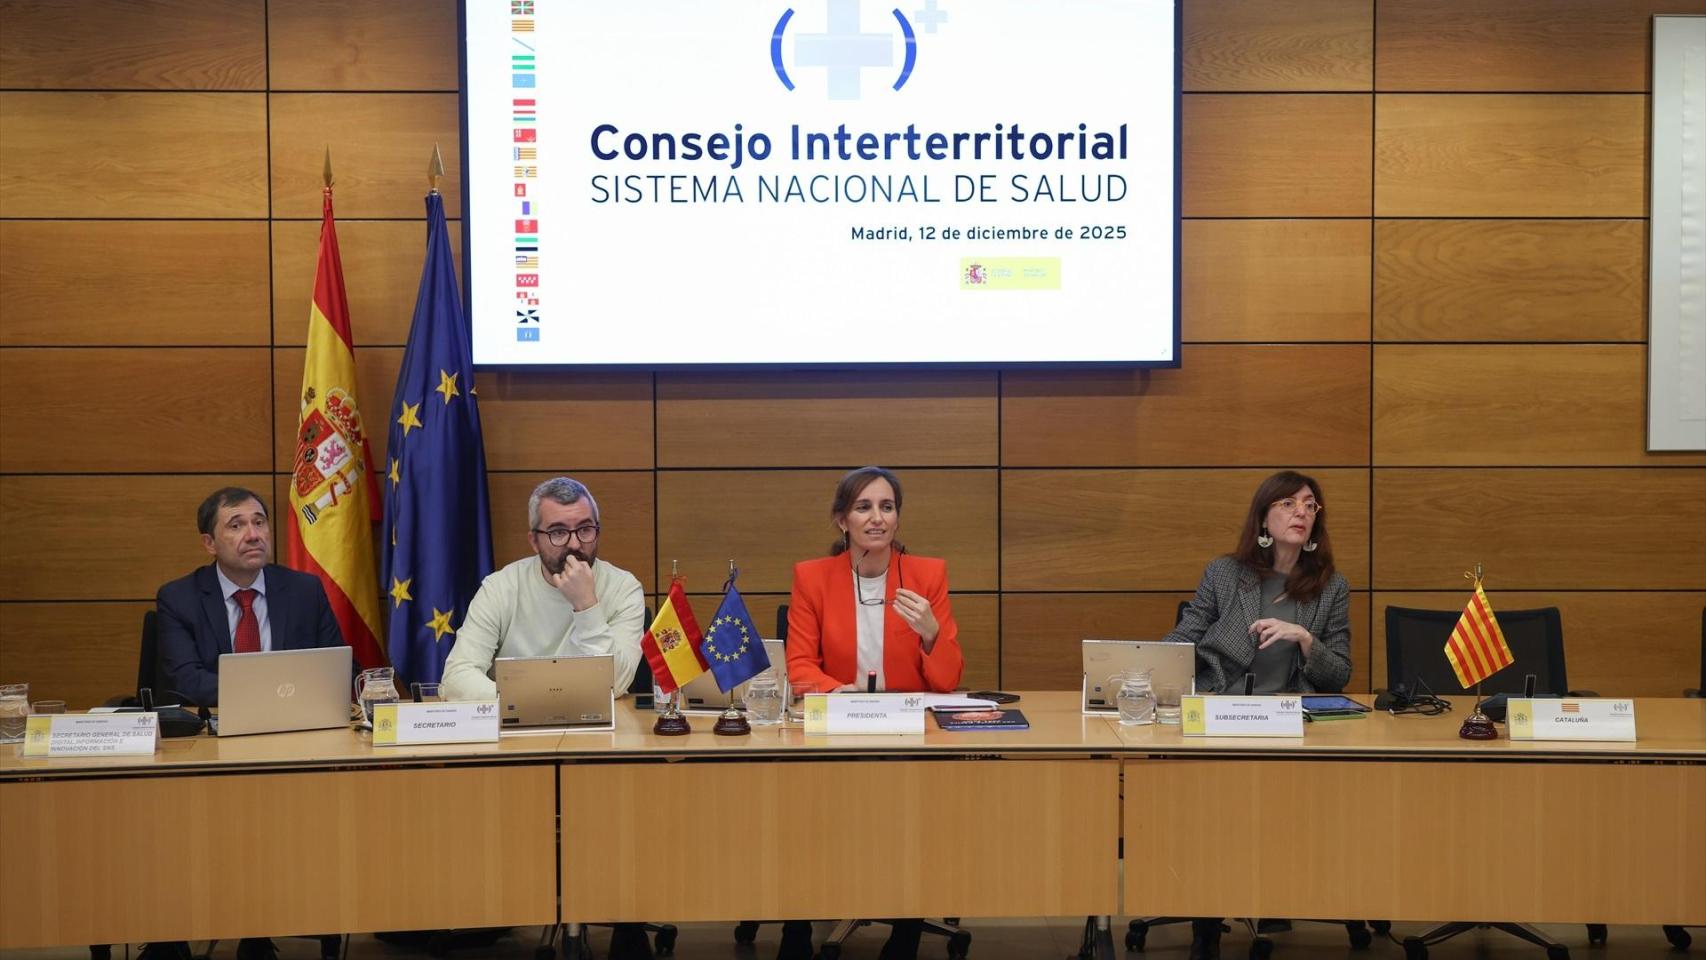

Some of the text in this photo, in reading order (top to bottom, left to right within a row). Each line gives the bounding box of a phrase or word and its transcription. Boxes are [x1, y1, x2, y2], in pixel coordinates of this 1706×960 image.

[591, 123, 1127, 169] Consejo Interterritorial
[591, 174, 1127, 203] SISTEMA NACIONAL DE SALUD
[852, 226, 1126, 242] Madrid, 12 de diciembre de 2025
